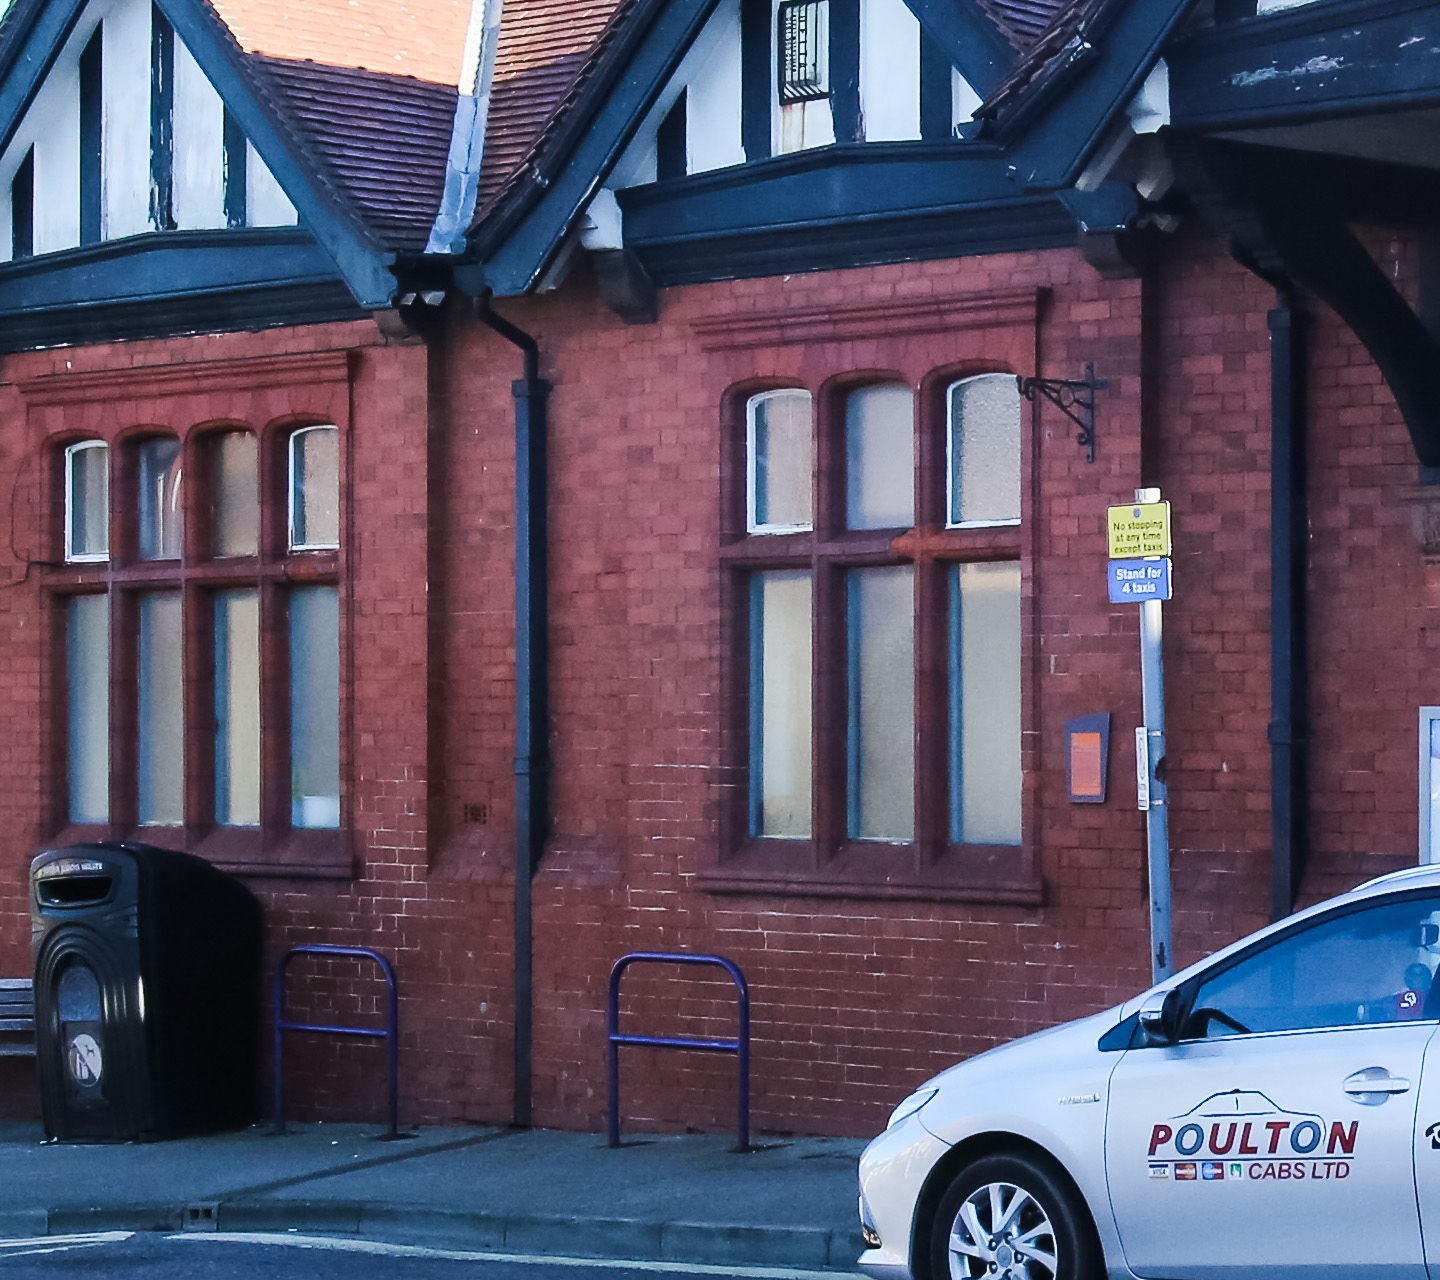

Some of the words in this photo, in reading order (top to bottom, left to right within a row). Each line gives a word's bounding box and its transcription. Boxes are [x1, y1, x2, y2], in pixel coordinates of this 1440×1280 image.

[1113, 522, 1126, 531] No
[1127, 520, 1163, 531] stopping
[1116, 534, 1124, 542] at
[1126, 534, 1140, 542] any
[1142, 532, 1161, 540] time
[1114, 544, 1141, 554] except
[1143, 543, 1163, 551] taxis
[1116, 567, 1145, 581] Stand
[1147, 566, 1162, 579] for
[1122, 582, 1130, 593] 4
[1132, 581, 1156, 593] taxis
[1147, 1119, 1359, 1157] POULTON
[1248, 1161, 1306, 1180] CABS
[1311, 1161, 1350, 1180] LTD
